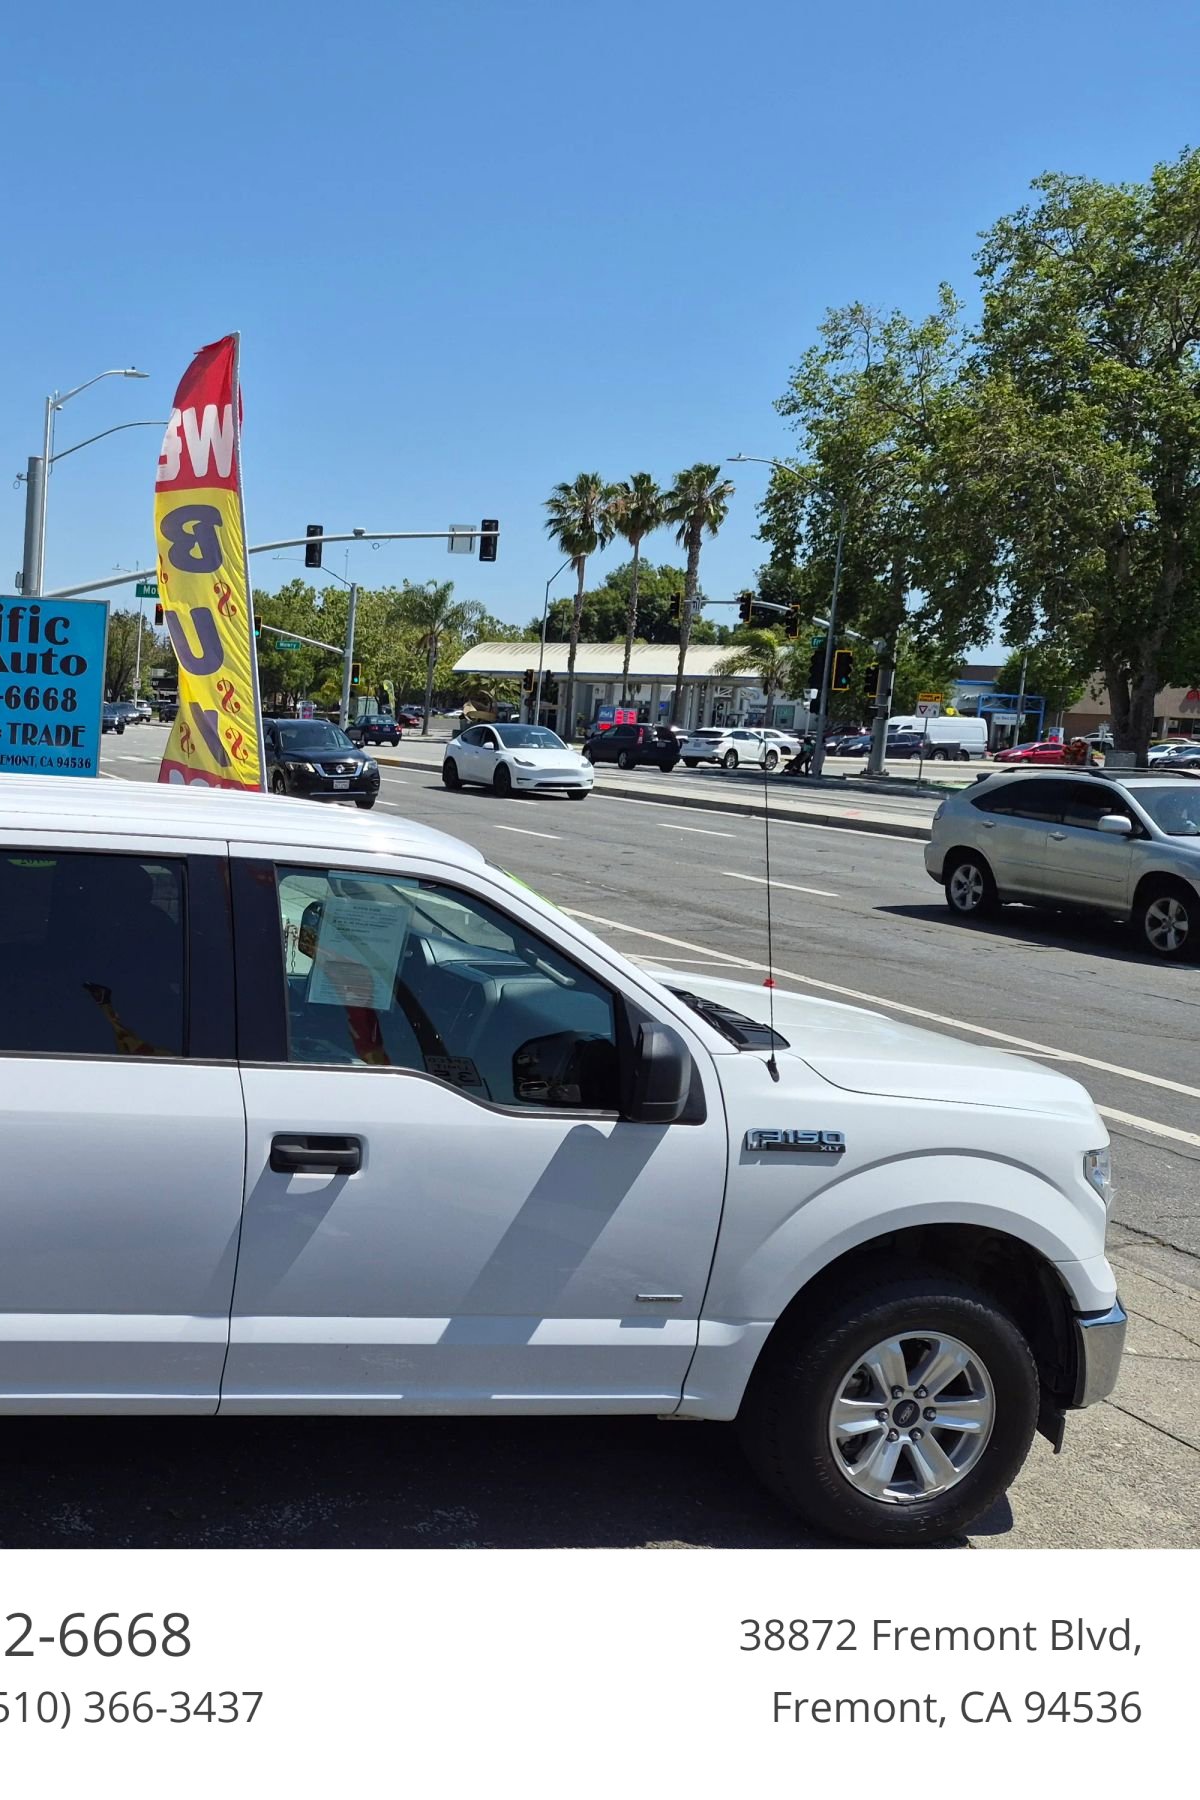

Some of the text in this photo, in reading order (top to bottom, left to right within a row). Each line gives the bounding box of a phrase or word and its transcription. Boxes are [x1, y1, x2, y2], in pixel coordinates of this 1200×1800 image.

[143, 585, 159, 595] Mo
[6, 722, 86, 748] TRADE
[40, 756, 54, 768] CA
[56, 757, 91, 769] 94536
